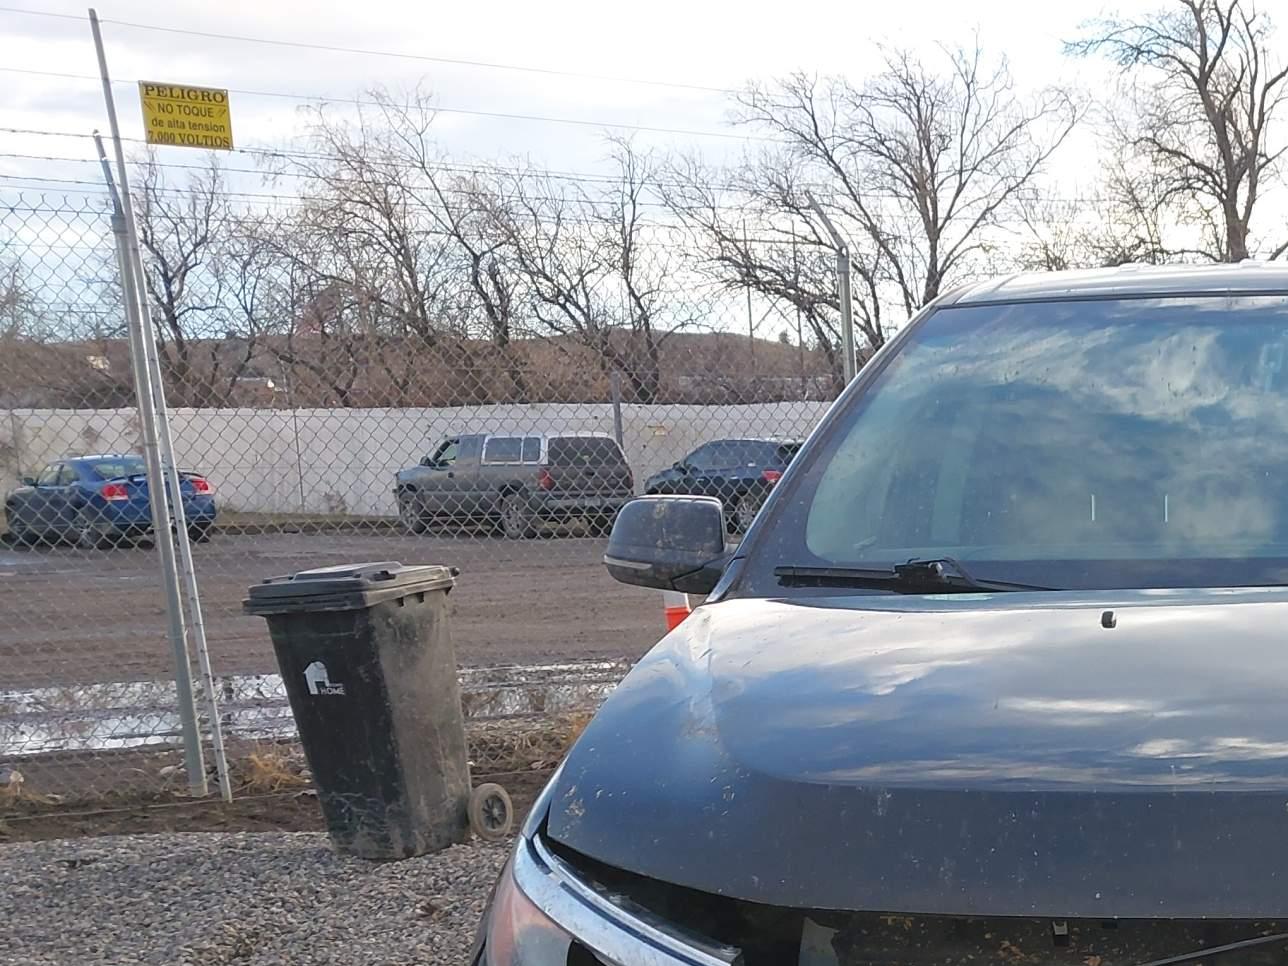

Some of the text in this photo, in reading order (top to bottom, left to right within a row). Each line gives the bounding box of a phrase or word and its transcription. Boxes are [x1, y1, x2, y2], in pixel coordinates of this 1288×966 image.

[144, 85, 225, 103] PELIGRO
[157, 103, 214, 118] NO TOQUE
[151, 117, 225, 132] de alta tension
[178, 132, 230, 148] VOLTIOS
